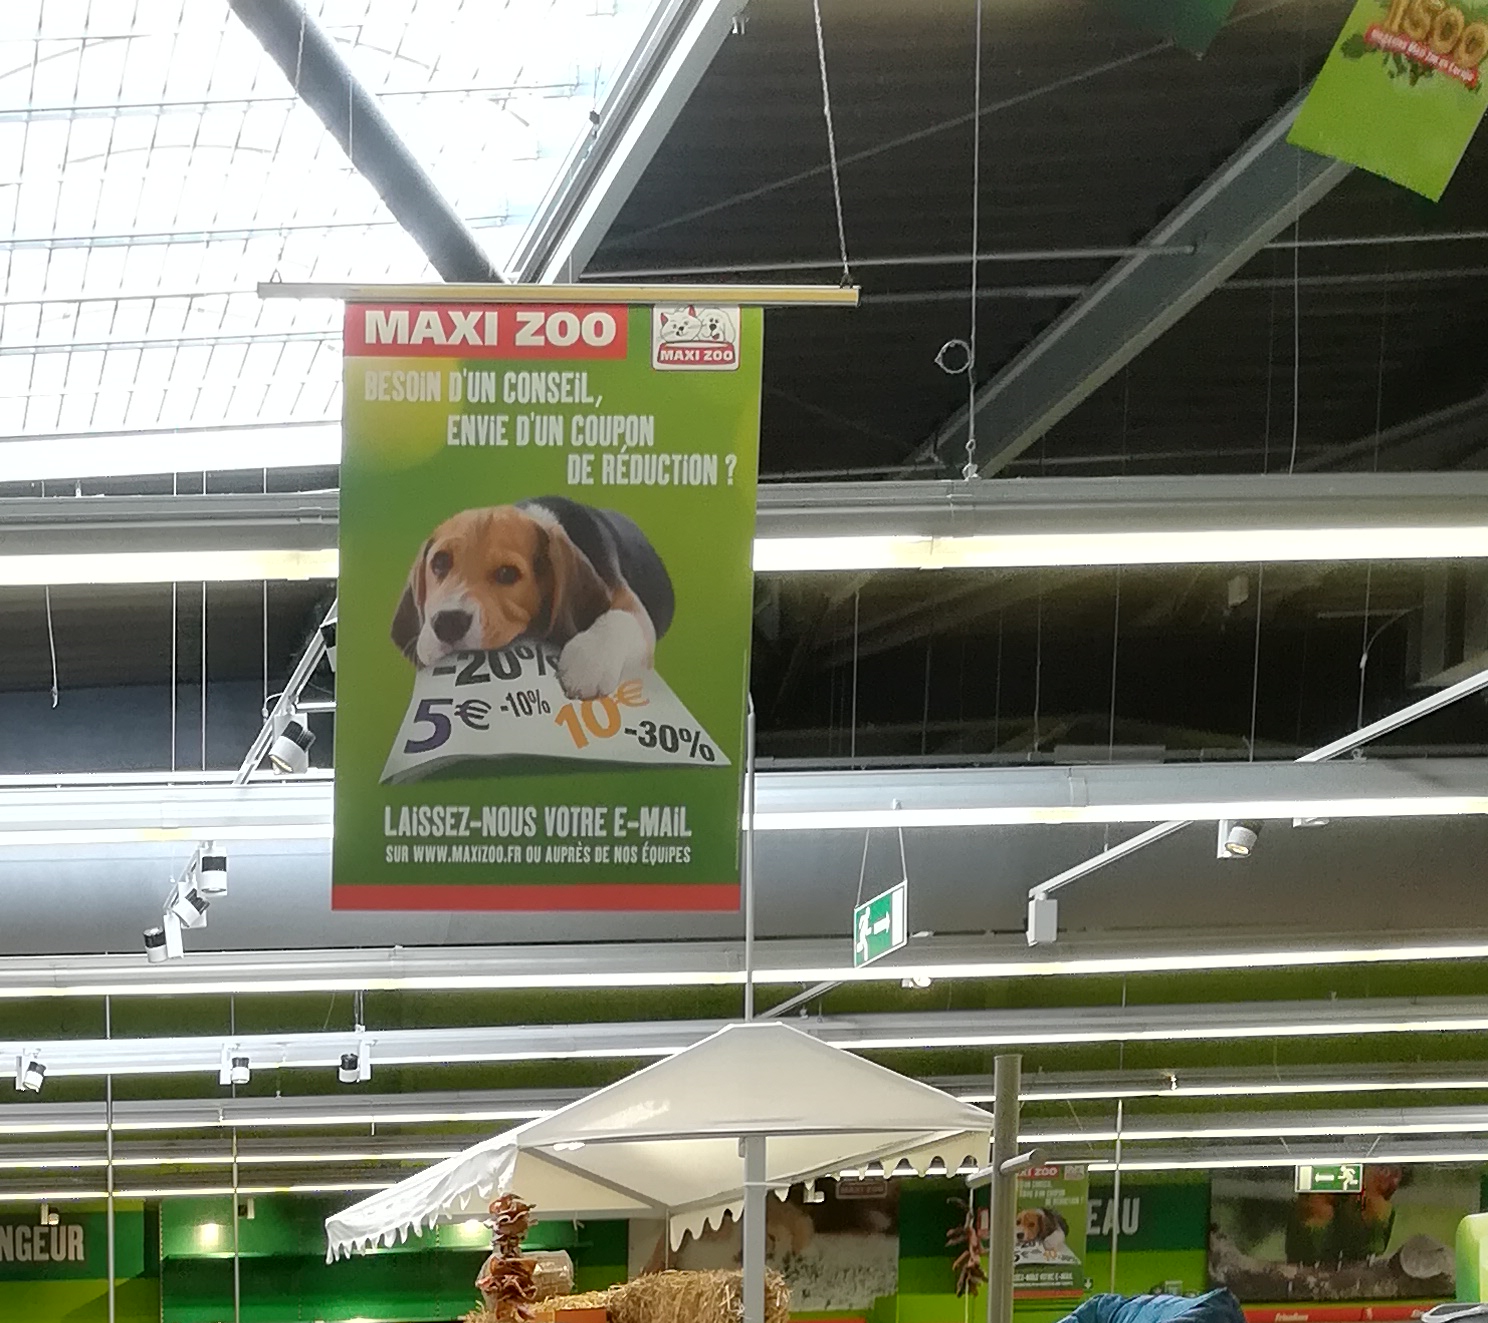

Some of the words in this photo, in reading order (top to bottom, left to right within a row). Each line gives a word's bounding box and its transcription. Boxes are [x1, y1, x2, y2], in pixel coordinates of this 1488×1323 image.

[365, 310, 498, 345] MAXI
[514, 311, 617, 346] ZOO
[660, 349, 700, 361] MAXI
[705, 350, 734, 361] ZOO
[449, 368, 497, 403] D'UN
[516, 414, 563, 446] D'UN
[571, 415, 655, 447] COUPON
[567, 453, 594, 485] DE
[725, 454, 738, 486] ?
[500, 688, 551, 719] -10%
[624, 720, 715, 762] -30%
[544, 806, 608, 838] VOTRE
[386, 845, 409, 863] SUR
[526, 846, 541, 864] OU
[545, 841, 590, 864] AUPRÈS
[595, 846, 610, 864] DE
[613, 846, 638, 865] NOS
[1087, 1198, 1140, 1236] EAU
